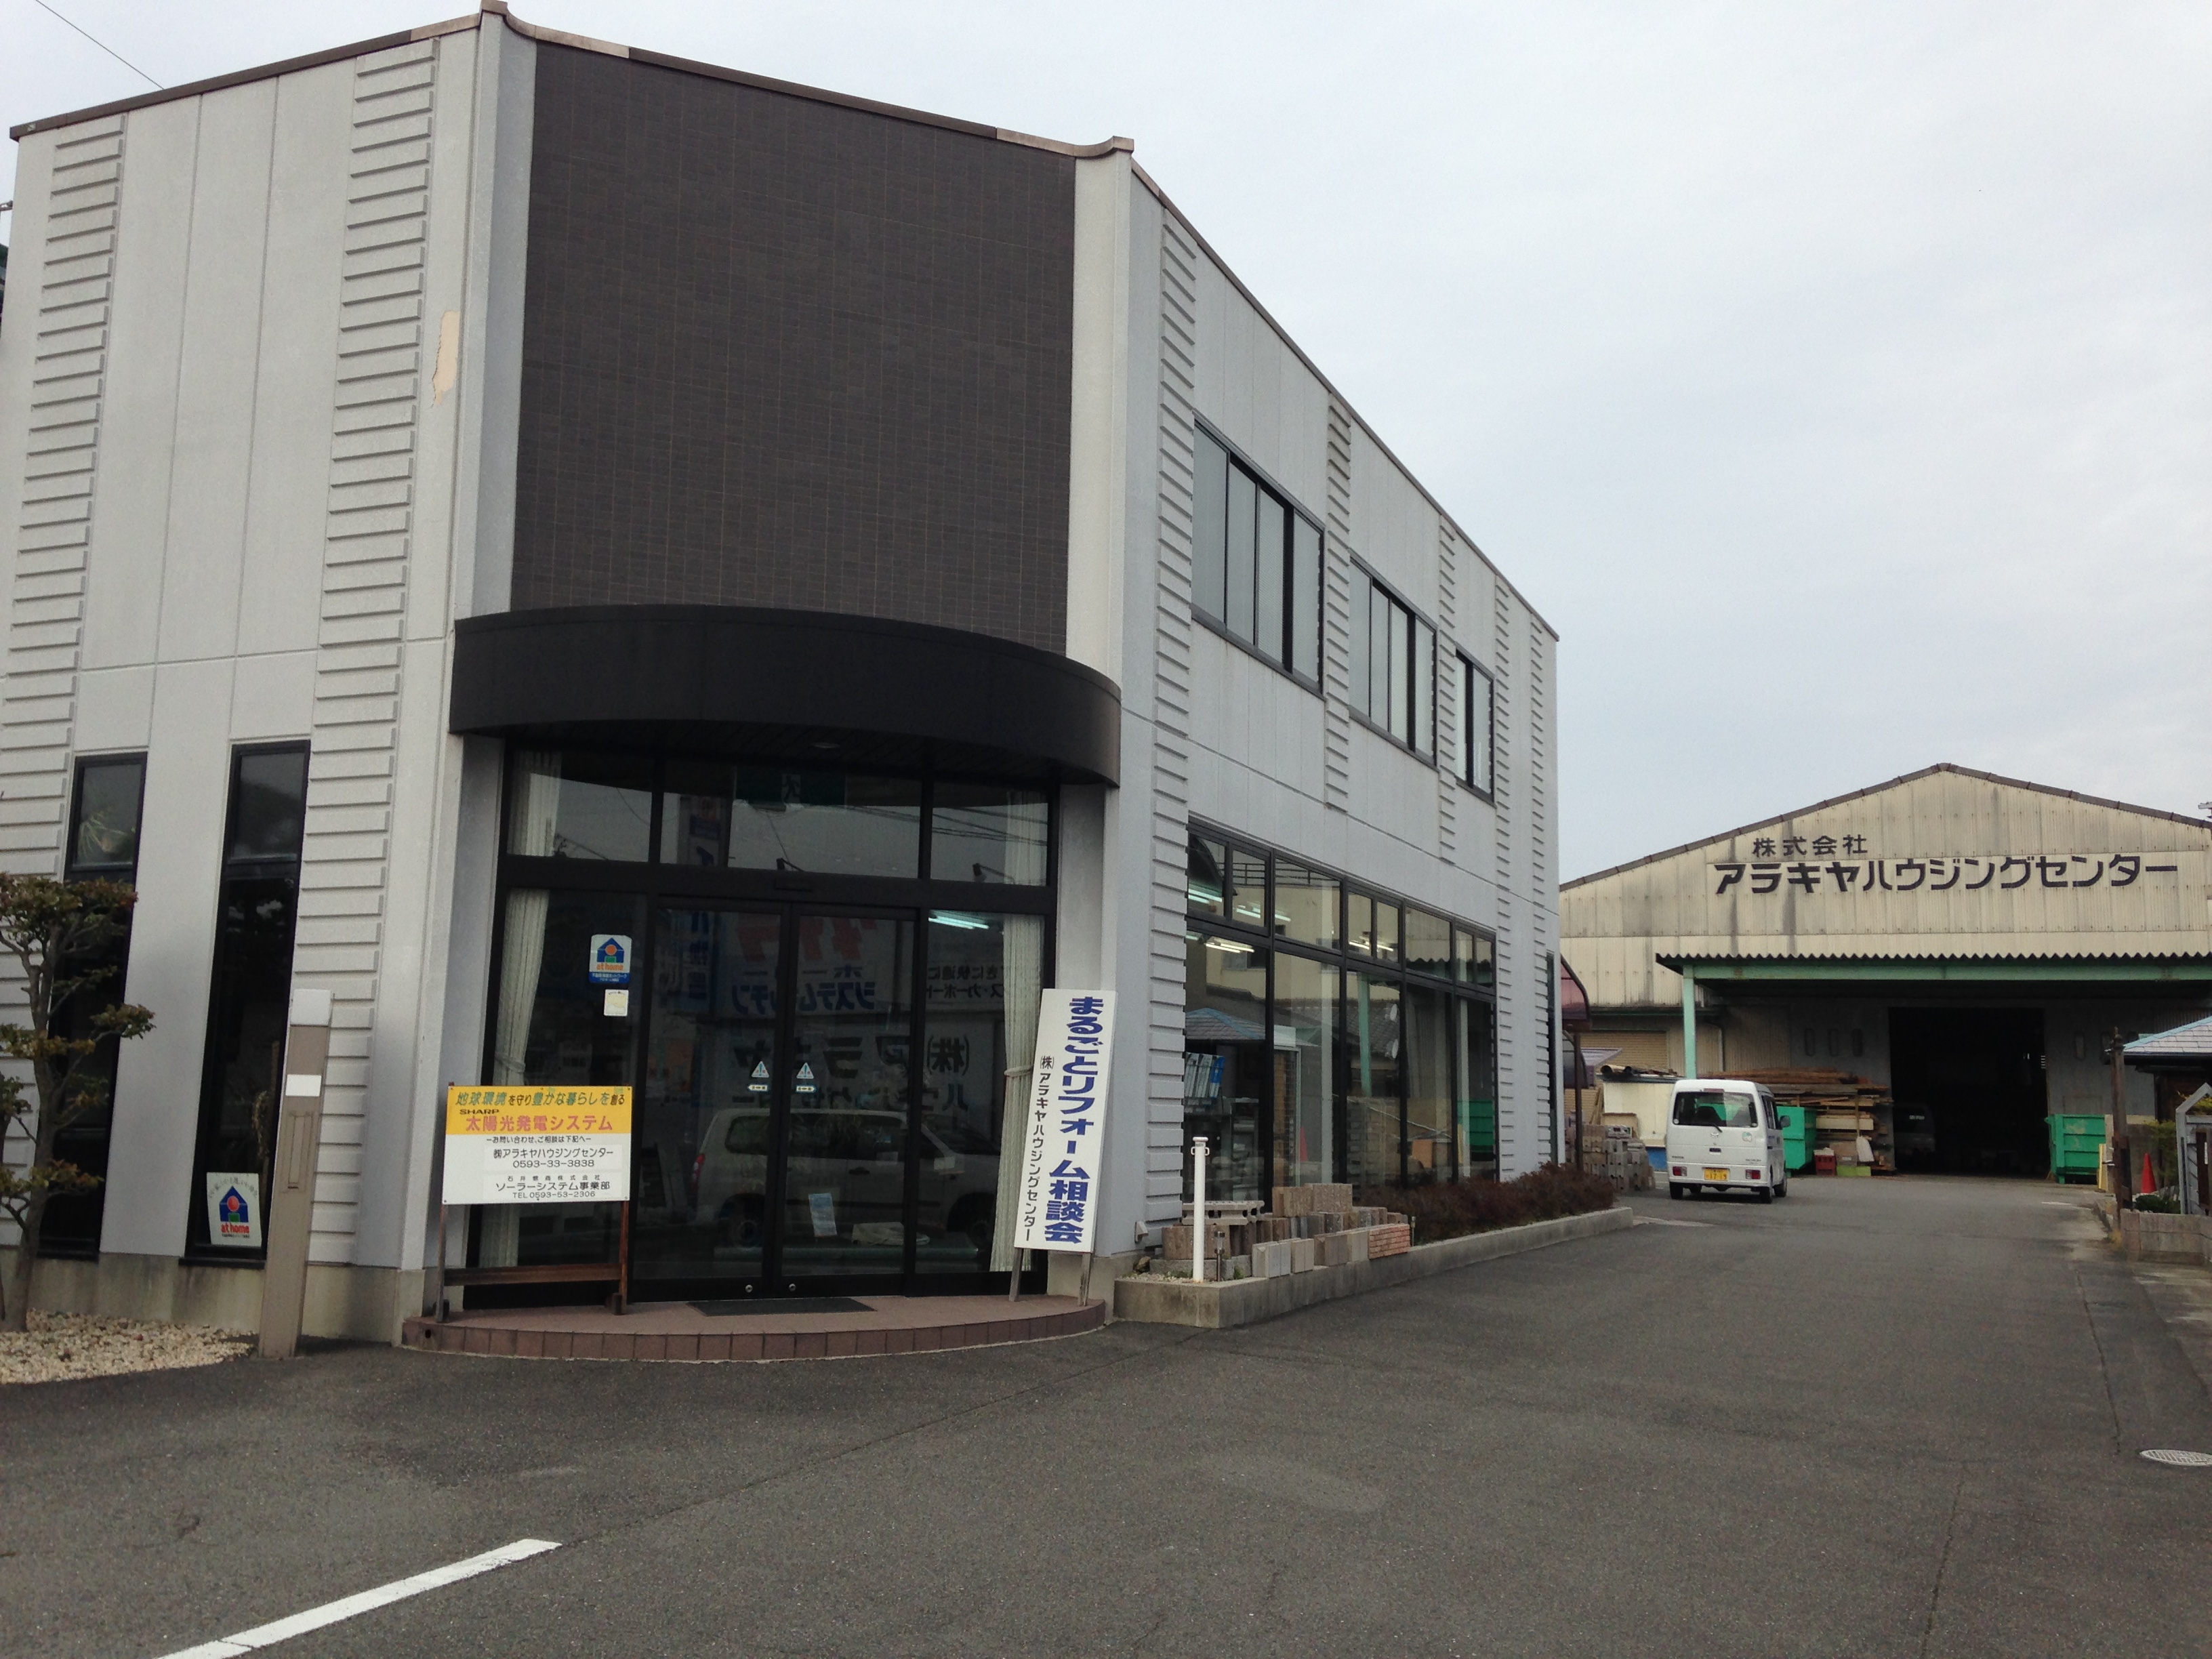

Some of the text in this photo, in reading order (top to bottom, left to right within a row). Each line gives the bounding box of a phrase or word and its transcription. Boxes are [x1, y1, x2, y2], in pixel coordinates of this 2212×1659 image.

[1753, 834, 1868, 858] 株式会社
[1713, 854, 2177, 895] アラキヤハウジングセンター
[466, 1115, 613, 1132] 太陽光発電システム
[1044, 996, 1104, 1244] まるごとリフォーム相談会
[513, 1160, 594, 1168] 0593-33-3838
[496, 1181, 610, 1191] ソーラーシステム事業部
